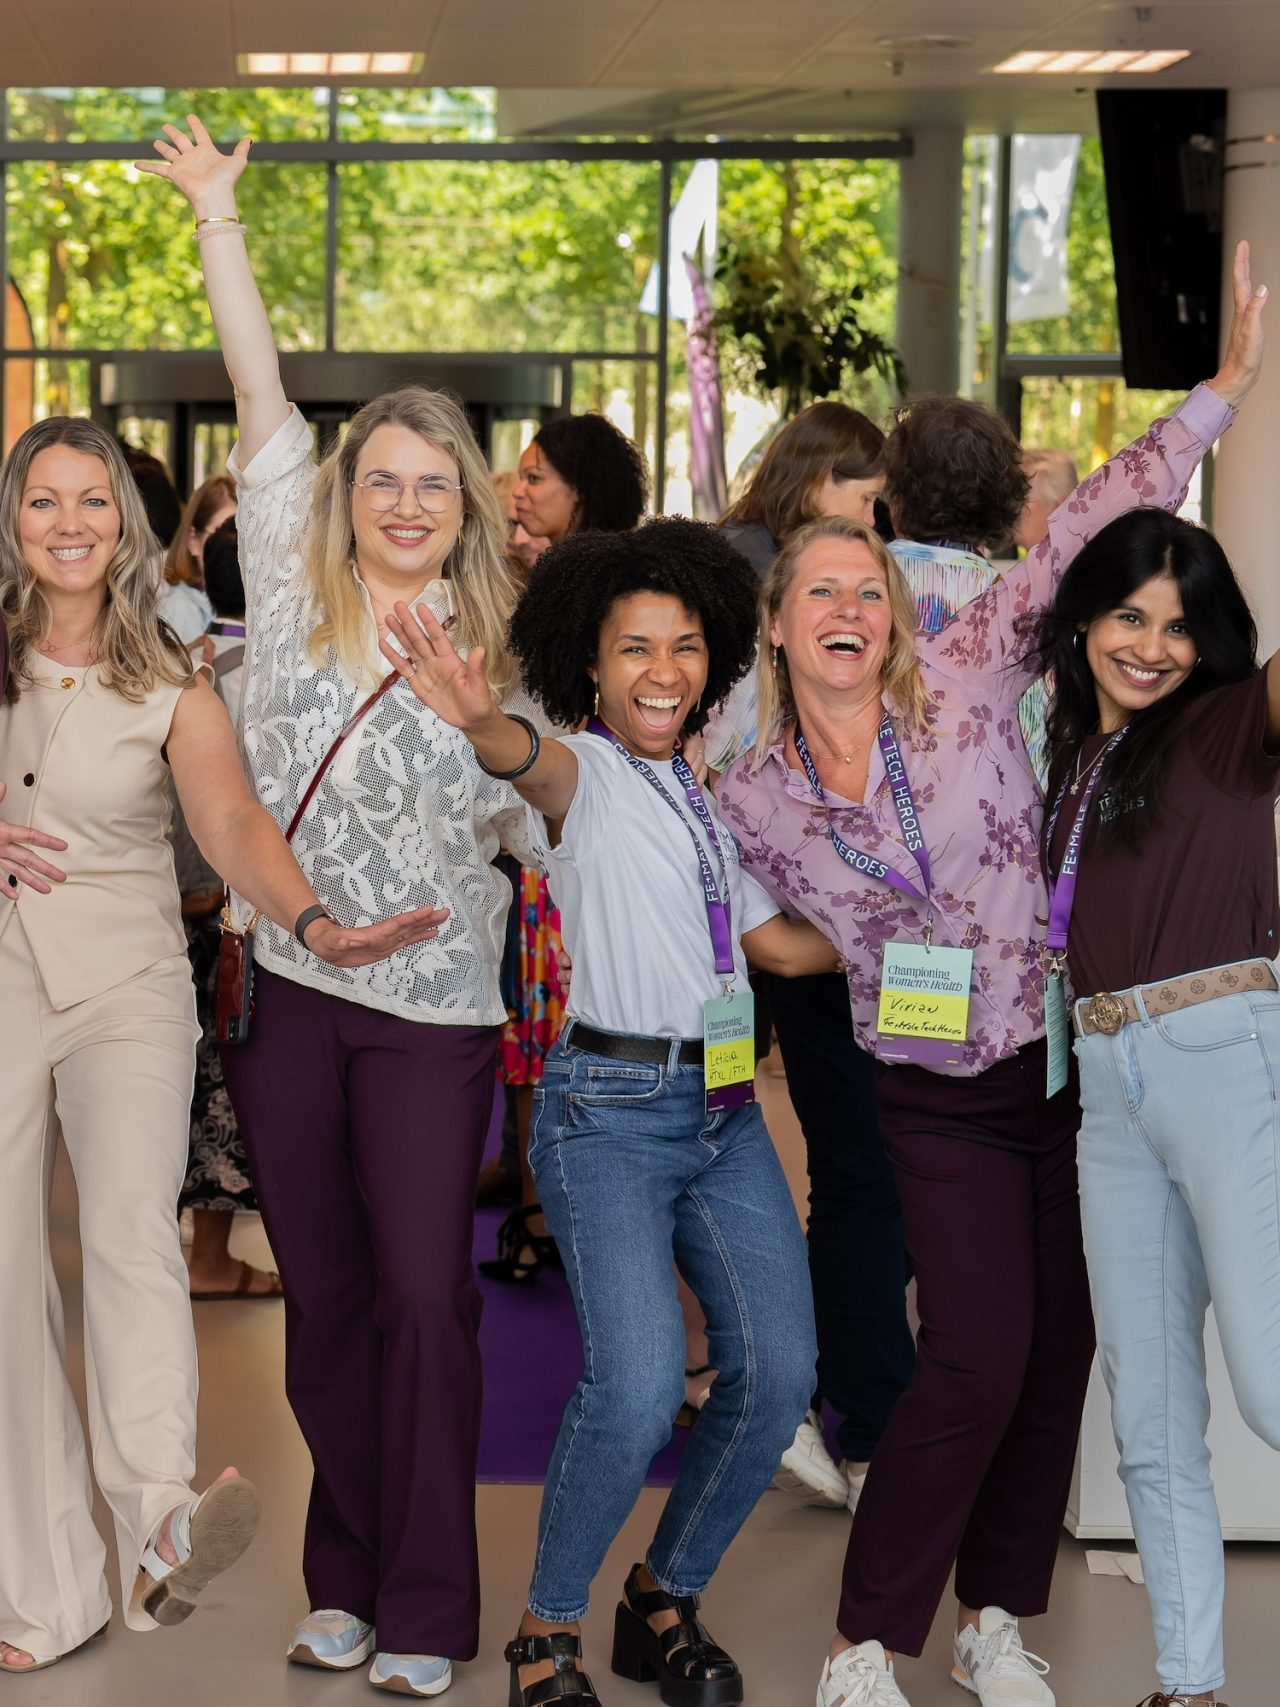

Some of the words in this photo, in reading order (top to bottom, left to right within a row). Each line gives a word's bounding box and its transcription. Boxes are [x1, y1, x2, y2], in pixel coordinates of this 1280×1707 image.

[795, 736, 823, 796] FE+MALE
[690, 796, 714, 833] TECH
[883, 741, 905, 783] TECH
[894, 786, 923, 852] HEROES
[832, 834, 889, 878] HEROES
[1062, 804, 1088, 875] FE+MALE
[695, 840, 719, 902] FE+MAL
[887, 965, 951, 981] Championing
[888, 976, 929, 989] Women's
[930, 980, 963, 992] Health
